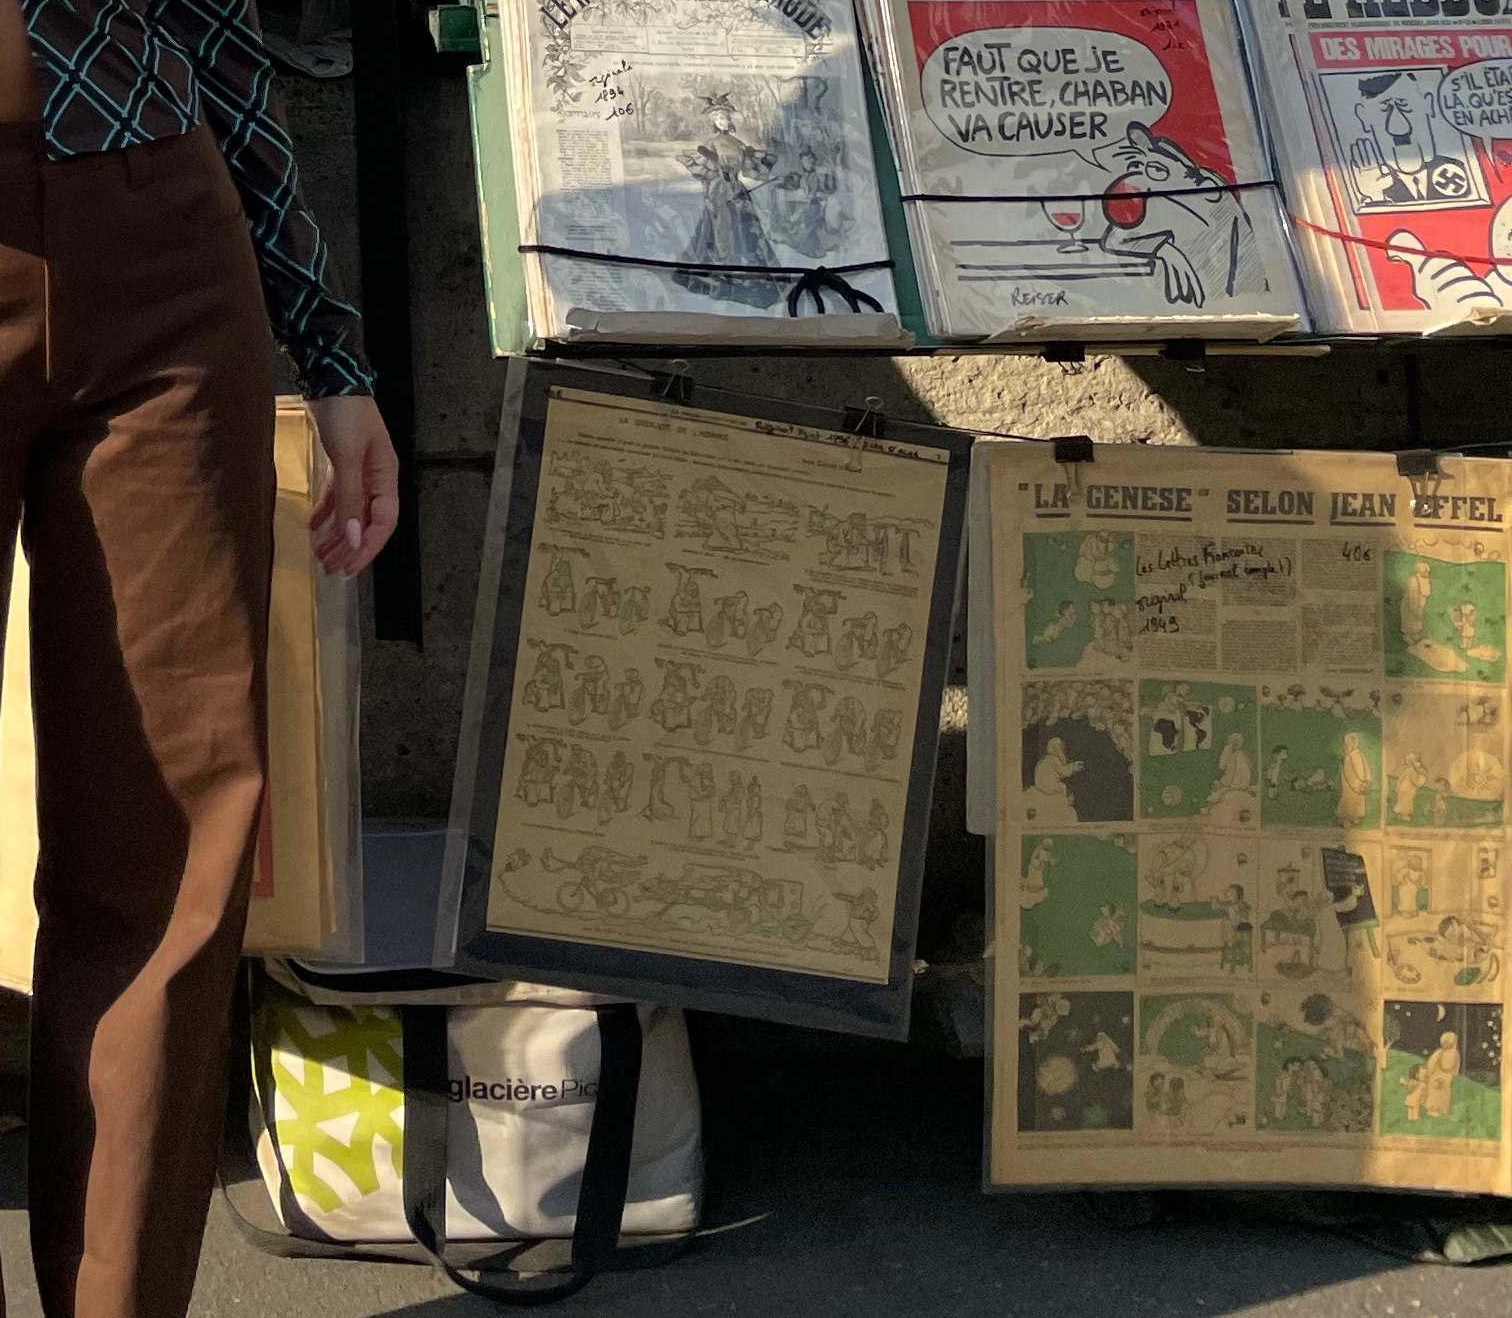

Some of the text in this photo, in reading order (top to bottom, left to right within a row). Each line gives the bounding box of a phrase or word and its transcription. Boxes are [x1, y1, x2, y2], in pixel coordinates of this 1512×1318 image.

[943, 43, 1012, 76] FAUT
[1017, 48, 1081, 75] QUE
[1319, 35, 1512, 61] DES MIRAGES POUR
[940, 76, 1169, 110] RENTRE, CHABAN
[1451, 70, 1484, 92] S'IL
[948, 111, 1109, 143] VA CAUSER
[1453, 110, 1475, 126] EN
[1227, 488, 1315, 515] SELON
[1331, 492, 1397, 519] JEAN
[448, 1073, 559, 1104] glacière
